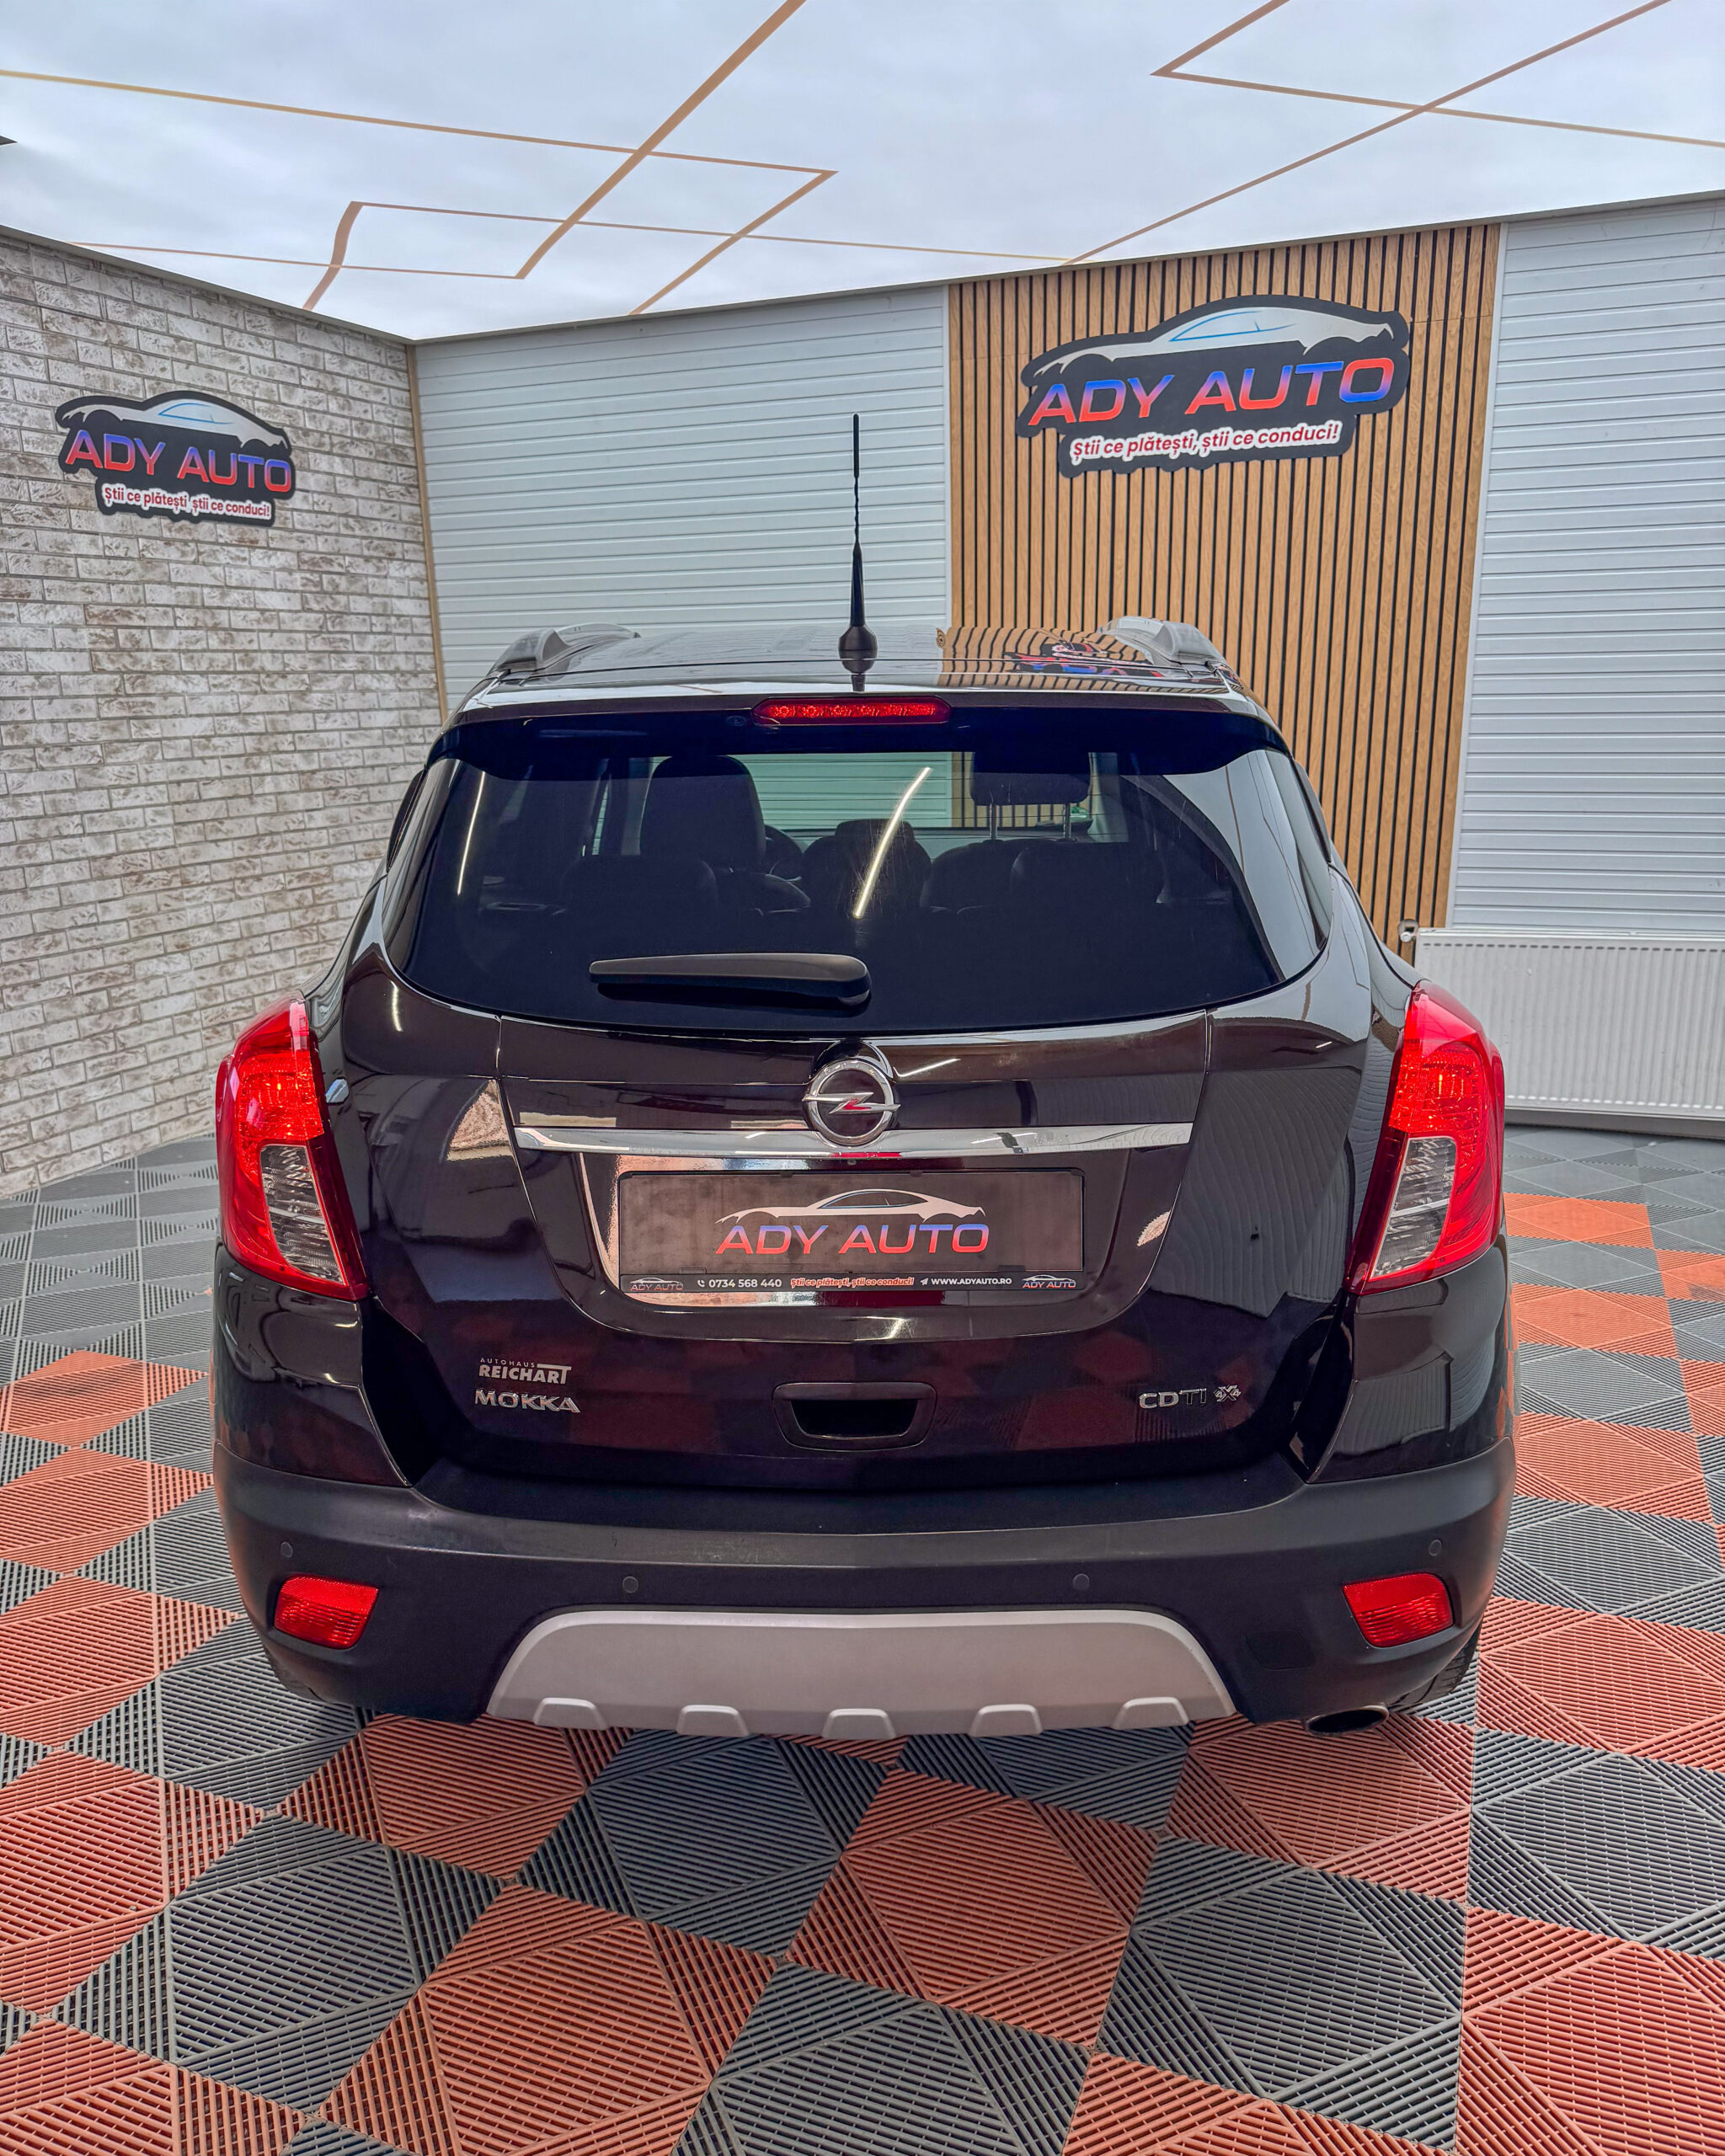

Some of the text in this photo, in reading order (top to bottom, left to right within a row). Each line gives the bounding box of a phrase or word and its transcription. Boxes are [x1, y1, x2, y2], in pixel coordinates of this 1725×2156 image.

[1028, 357, 1395, 426] ADY AUTO
[1073, 424, 1338, 461] Știi ce plătești, știi ce conduci!
[65, 430, 291, 493] ADY AUTO
[104, 487, 124, 504] Știi
[127, 492, 141, 501] ce
[192, 498, 209, 512] știi
[211, 501, 223, 510] ce
[226, 503, 270, 516] conduci!
[715, 1224, 990, 1255] ADY AUTO
[708, 1278, 782, 1288] 0734 568 440
[877, 1277, 915, 1286] conduci!
[478, 1364, 573, 1385] REICHART
[480, 1358, 535, 1368] AUTOHAUS
[475, 1389, 581, 1413] MOKKA
[1139, 1388, 1207, 1409] CDTI
